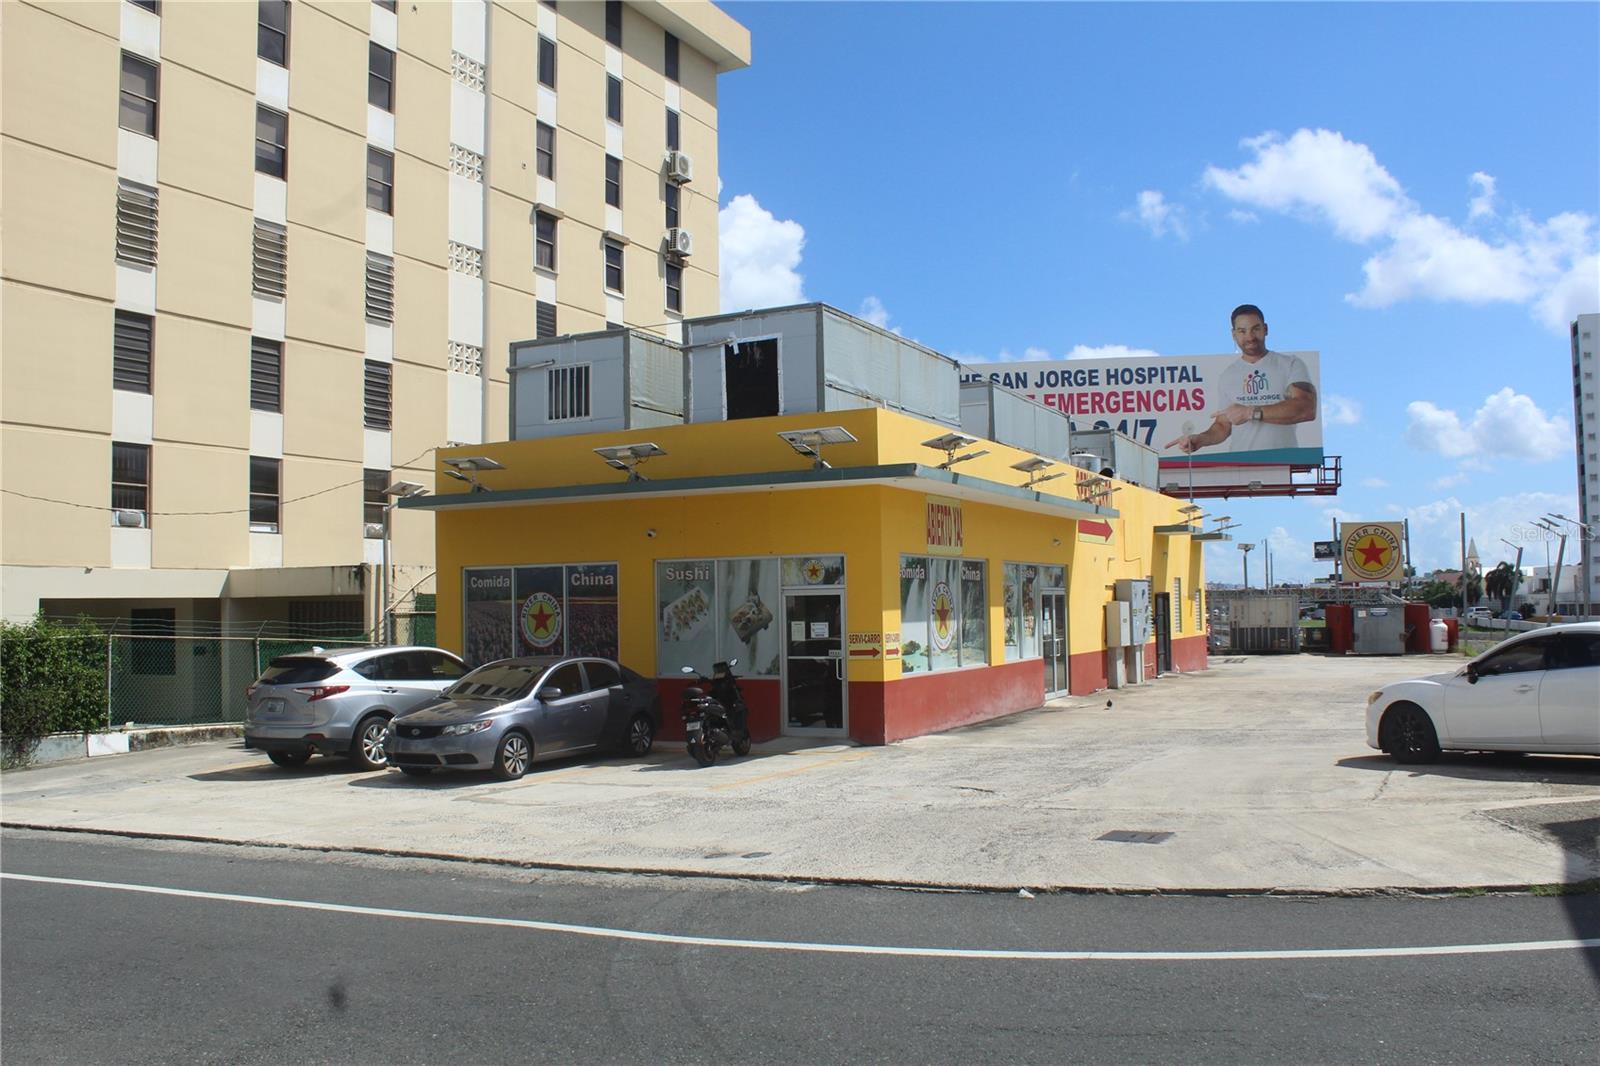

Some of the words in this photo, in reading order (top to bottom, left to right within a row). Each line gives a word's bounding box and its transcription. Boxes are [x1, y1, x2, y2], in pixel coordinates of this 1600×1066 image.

[989, 371, 1028, 389] SAN
[1034, 368, 1099, 389] JORGE
[1106, 365, 1203, 386] HOSPITAL
[1043, 388, 1205, 415] EMERGENCIAS
[1346, 528, 1369, 552] RIVER
[1373, 527, 1398, 551] CHINA
[470, 576, 510, 588] Comida
[571, 573, 614, 587] China
[666, 567, 710, 581] Sushi
[961, 566, 980, 580] China
[542, 594, 561, 617] CHINA
